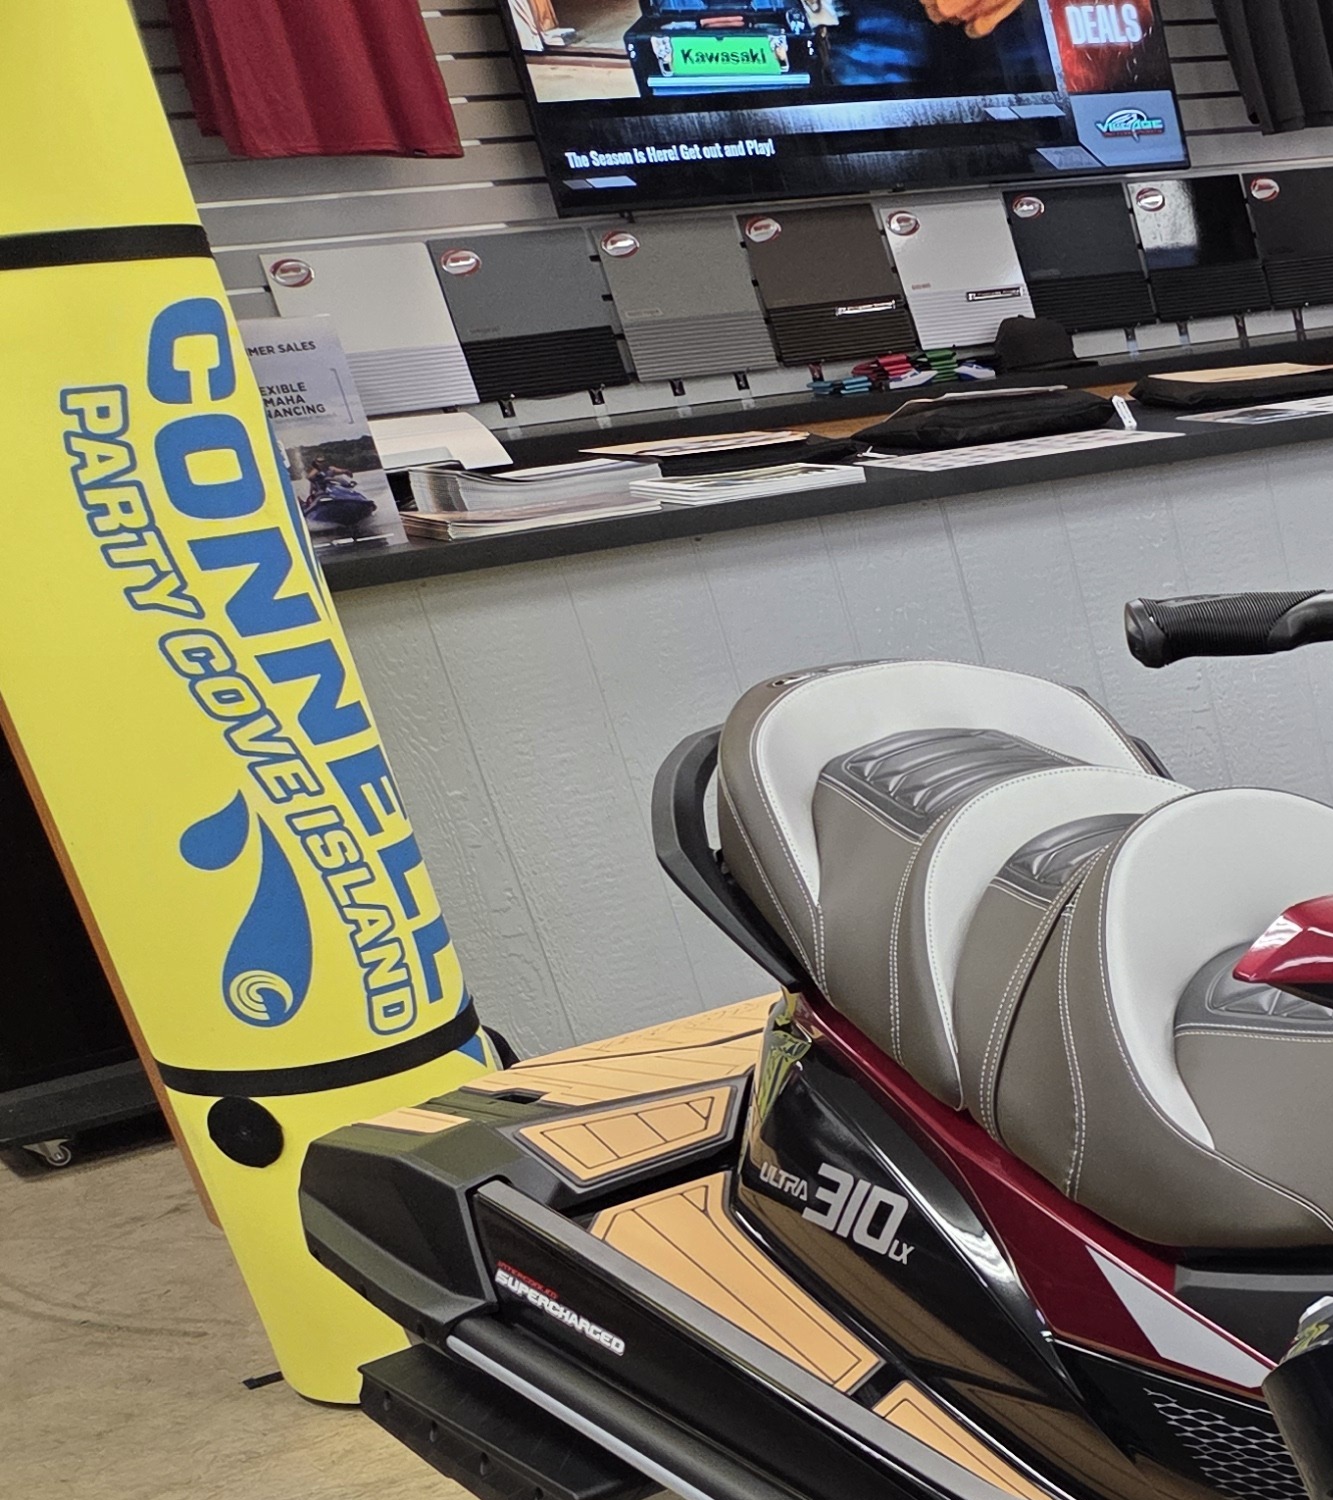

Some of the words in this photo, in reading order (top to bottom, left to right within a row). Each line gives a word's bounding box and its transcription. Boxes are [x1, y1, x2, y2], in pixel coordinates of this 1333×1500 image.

[1065, 3, 1142, 45] DEALS
[680, 47, 767, 65] Kawasaki
[565, 151, 590, 169] The
[590, 150, 633, 167] Season
[645, 145, 680, 163] Here!
[679, 143, 702, 161] Get
[702, 142, 722, 159] out
[724, 140, 745, 157] and
[745, 138, 776, 158] Play!
[246, 345, 275, 357] MER
[277, 340, 316, 354] SALES
[259, 381, 307, 396] EXIBLE
[263, 394, 306, 408] MAHA
[266, 403, 326, 419] NANCING
[60, 383, 206, 621] PARTY
[159, 626, 323, 806] COVE
[290, 805, 417, 1036] ISLAND
[759, 1162, 808, 1202] ULTRA
[801, 1162, 911, 1256] 310
[889, 1238, 916, 1265] LX
[495, 1267, 626, 1357] SUPERCHARGED
